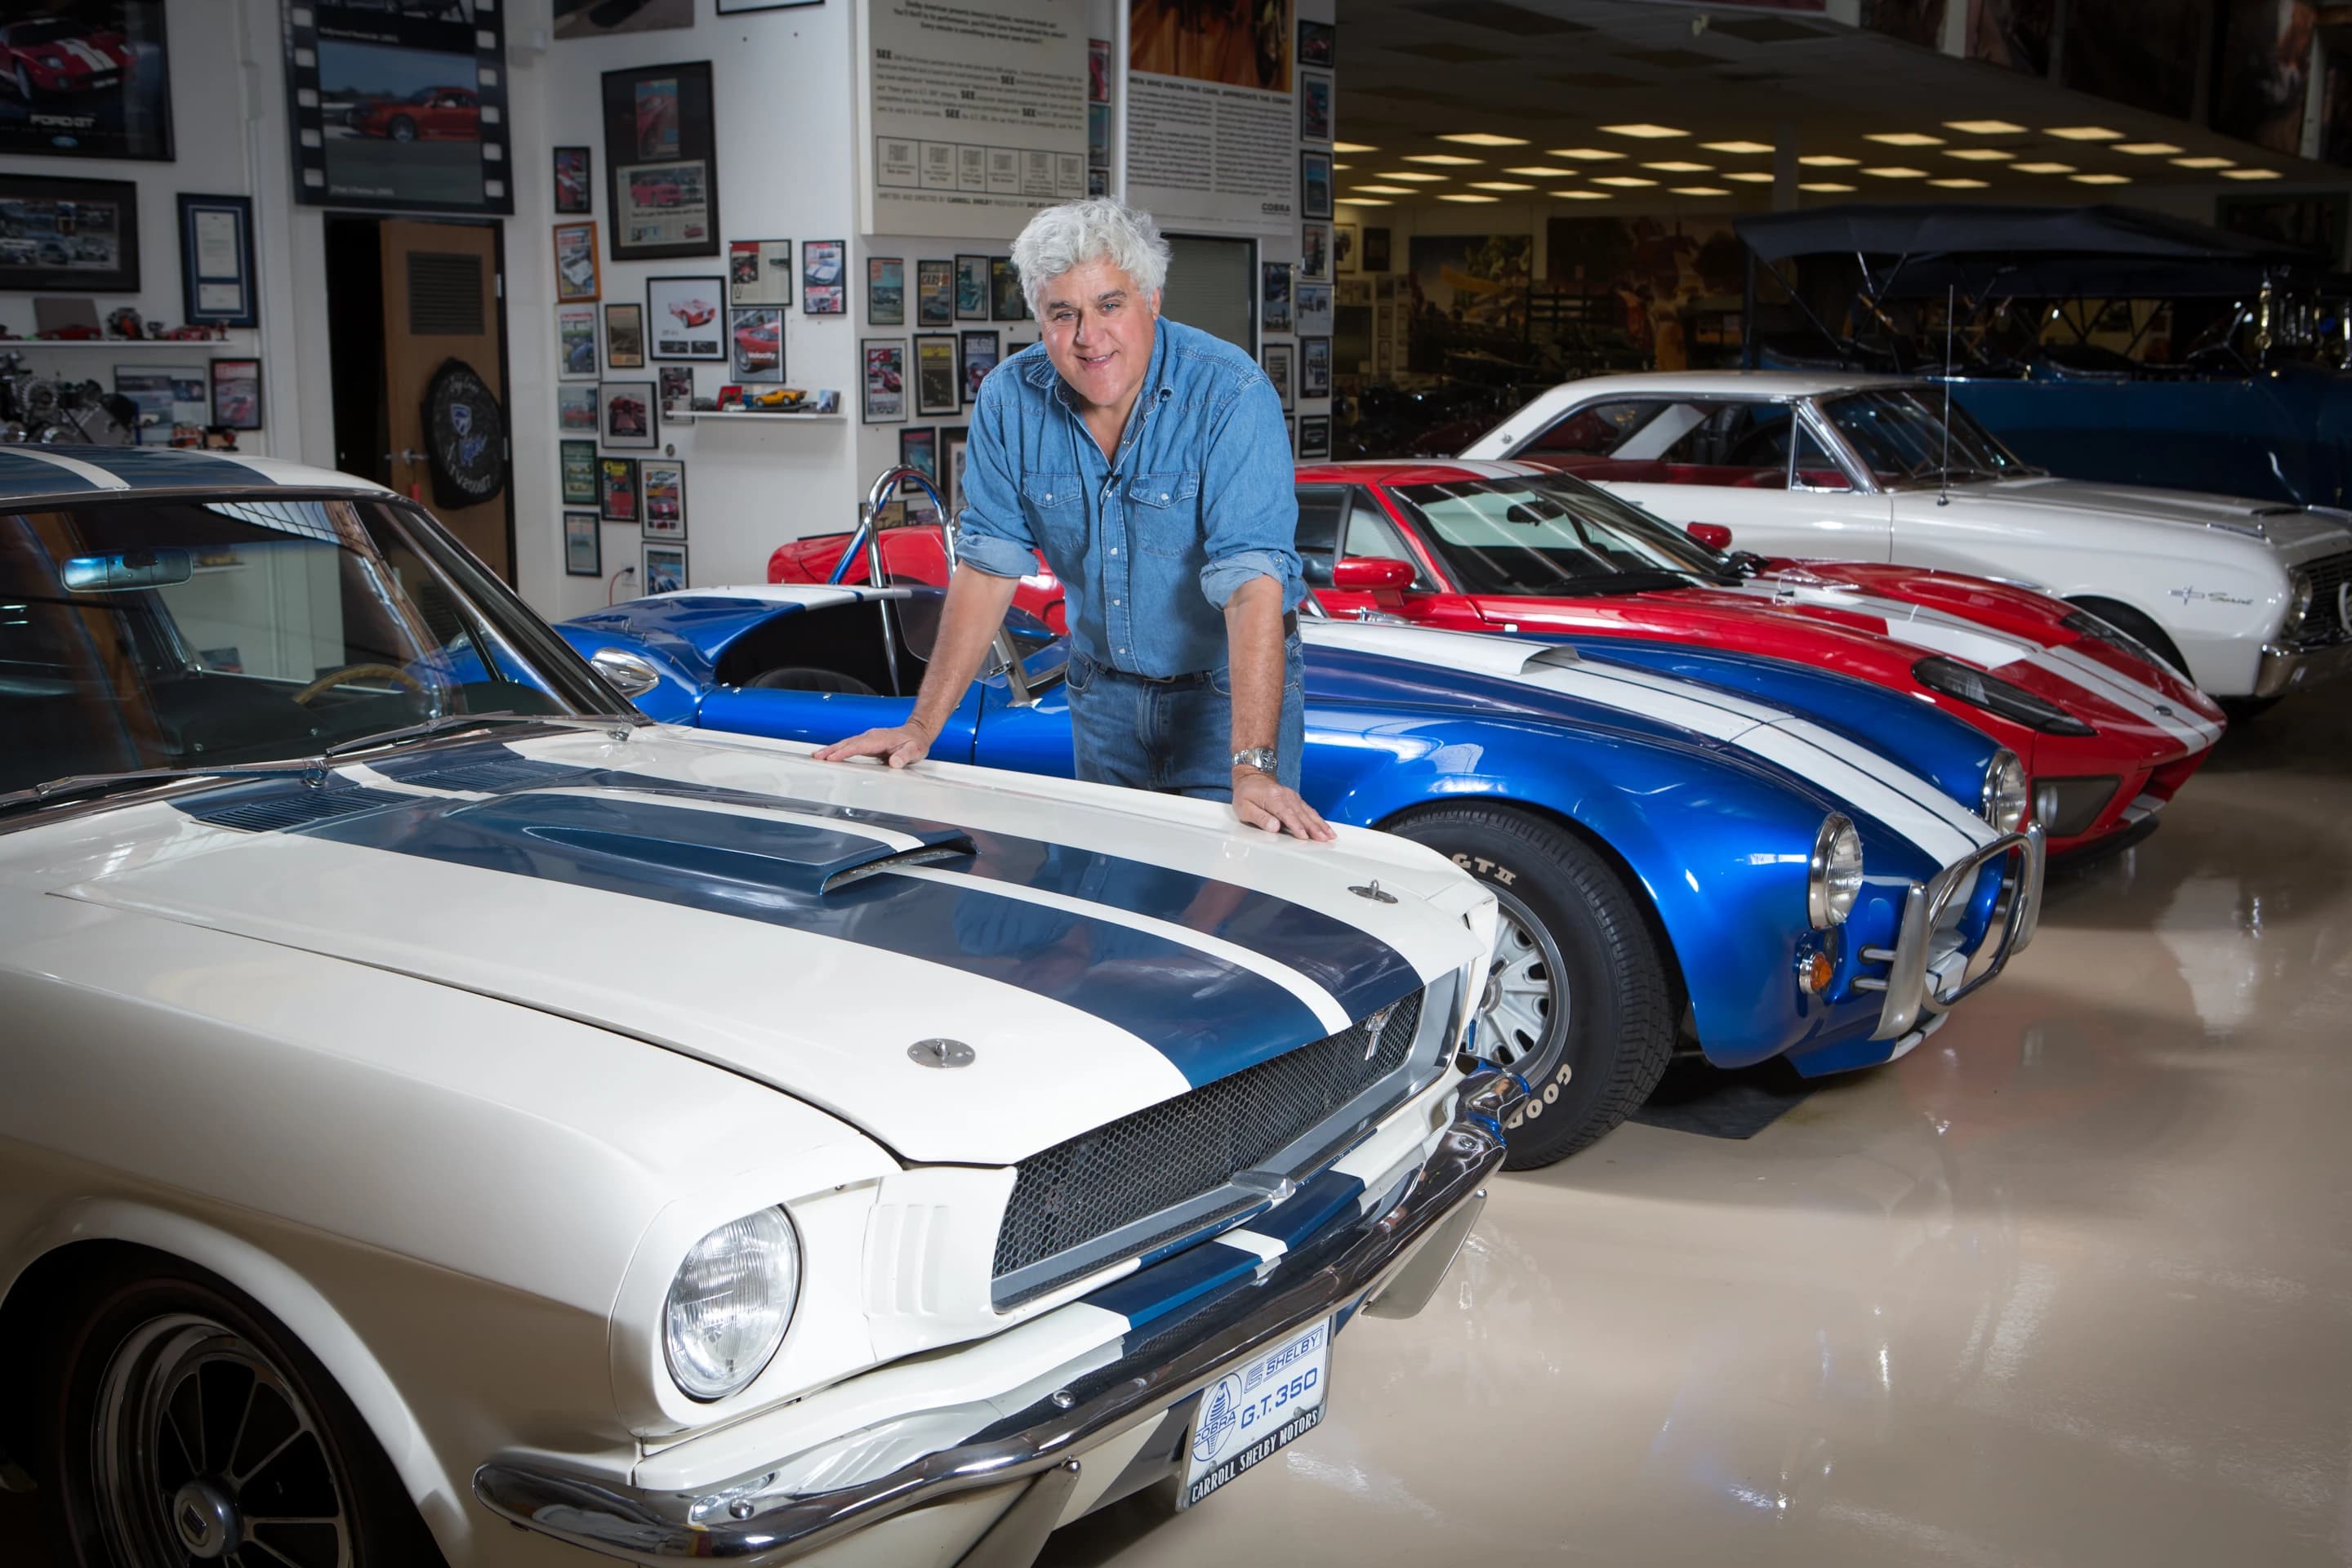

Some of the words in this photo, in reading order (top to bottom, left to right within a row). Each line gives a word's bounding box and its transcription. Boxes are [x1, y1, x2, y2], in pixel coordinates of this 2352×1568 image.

[876, 50, 893, 60] SEE
[1001, 75, 1015, 85] SEE
[1147, 79, 1163, 87] WHO
[1165, 82, 1184, 91] KNOW
[961, 90, 975, 100] SEE
[945, 109, 960, 118] SEE
[1022, 108, 1036, 118] SEE
[1262, 203, 1290, 212] COBRA
[746, 350, 777, 360] Velocity
[1452, 853, 1496, 874] GT
[1266, 1335, 1319, 1377] SHELBY
[1194, 1411, 1237, 1446] COBRA
[1192, 1466, 1237, 1503] CARROLL
[1239, 1434, 1278, 1472] SHELBY
[1279, 1409, 1319, 1448] MOTORS
